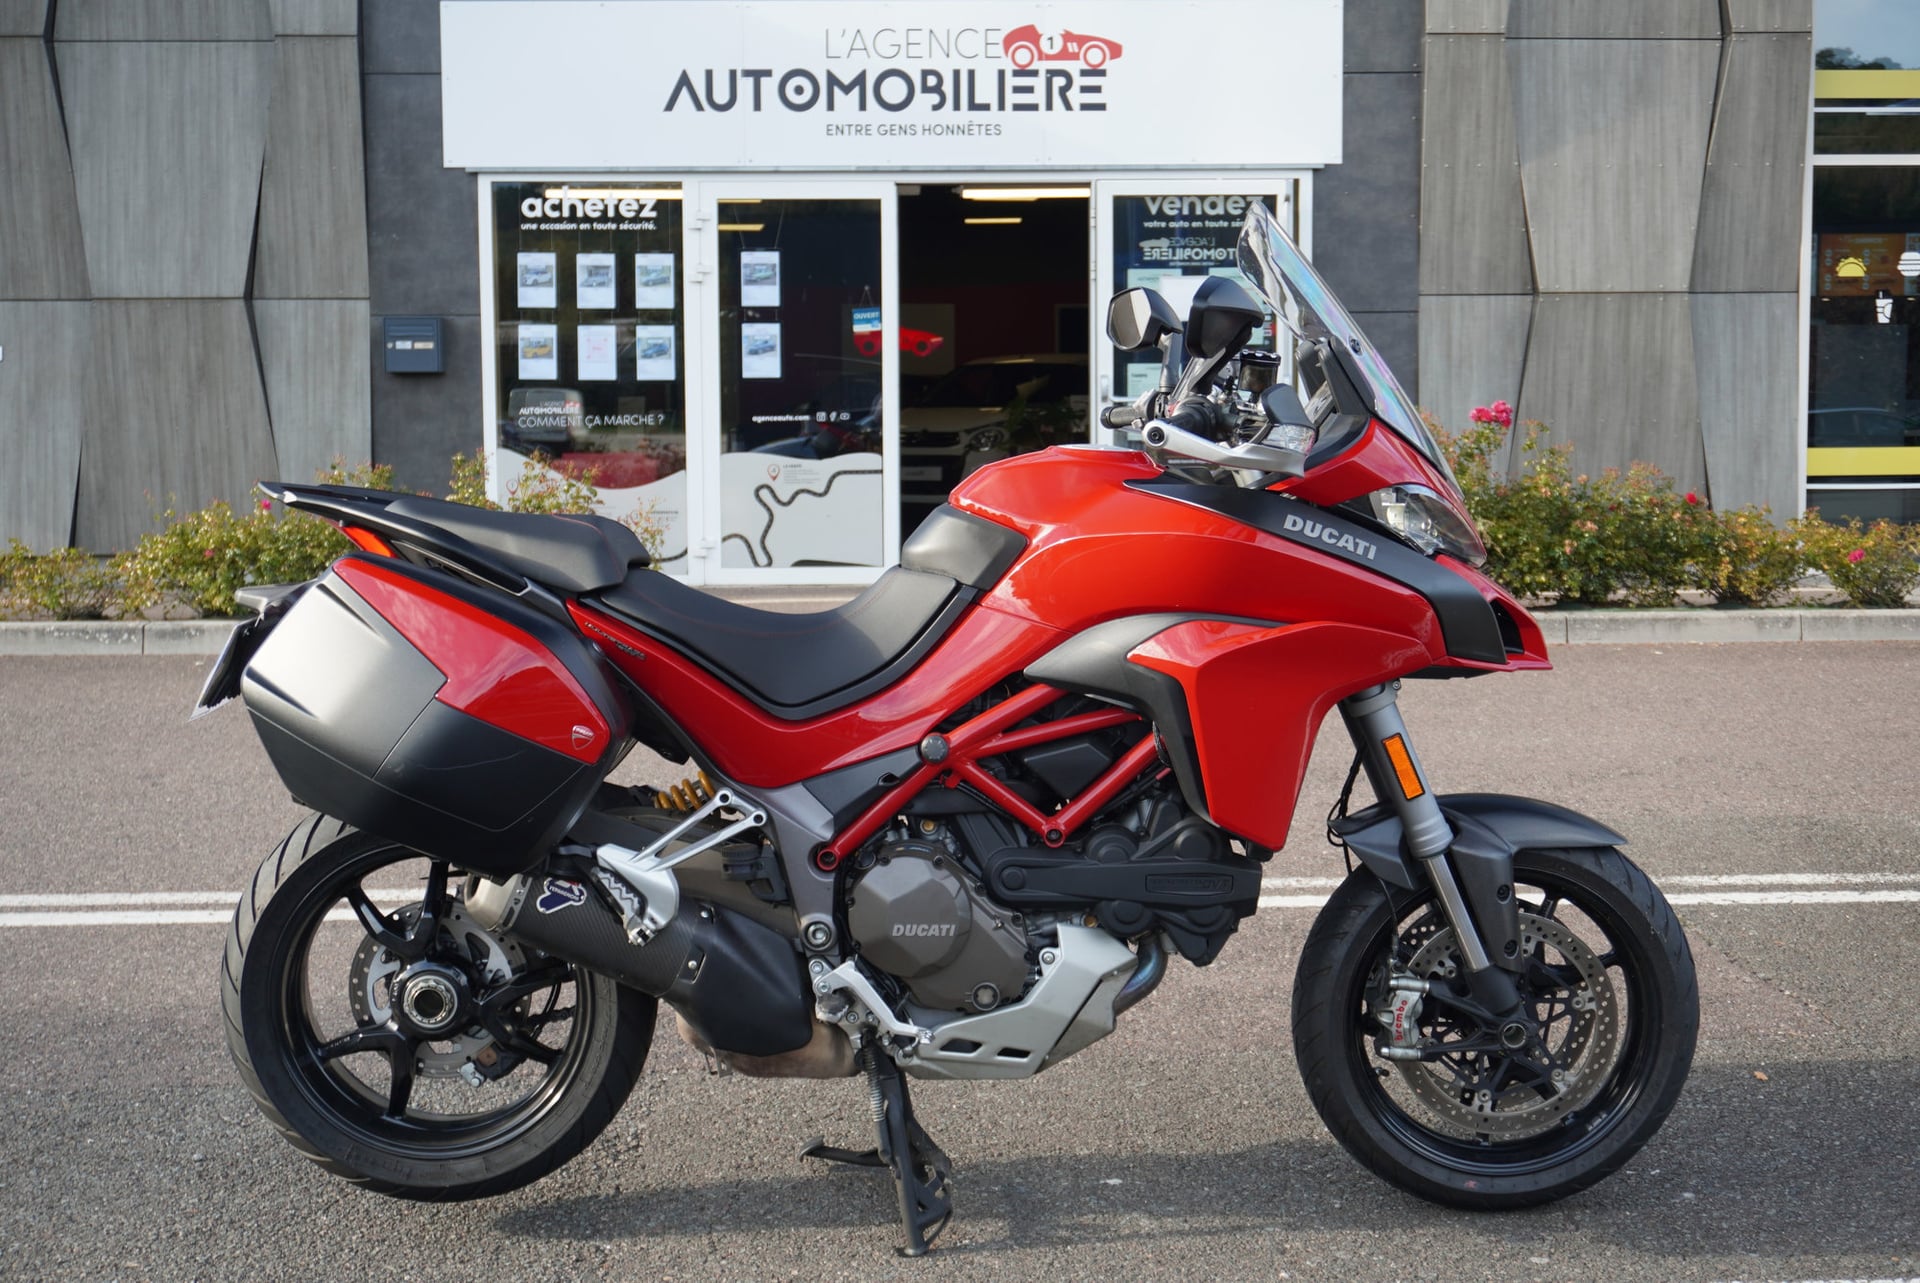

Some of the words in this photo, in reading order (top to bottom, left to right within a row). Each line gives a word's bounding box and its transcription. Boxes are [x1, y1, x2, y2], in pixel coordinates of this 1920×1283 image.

[825, 28, 1002, 60] L'AGENCE
[1046, 36, 1054, 50] 1
[826, 123, 873, 136] ENTRE
[877, 123, 918, 136] GENS
[922, 120, 1002, 136] HONNÊTES
[521, 185, 657, 218] achetez
[520, 222, 538, 230] une
[540, 220, 577, 230] occasion
[579, 222, 590, 230] en
[593, 221, 617, 230] toute
[619, 219, 657, 230] sécurité.
[1143, 220, 1167, 228] votre
[1168, 220, 1189, 228] auto
[1205, 219, 1228, 228] toute
[853, 311, 880, 320] OUVERT
[518, 415, 582, 428] COMMENT
[584, 415, 601, 428] ÇA
[604, 413, 655, 426] MARCHE
[657, 413, 664, 425] ?
[1283, 514, 1377, 560] DUCATI
[892, 924, 956, 937] DUCATI
[1394, 999, 1408, 1042] brembo
